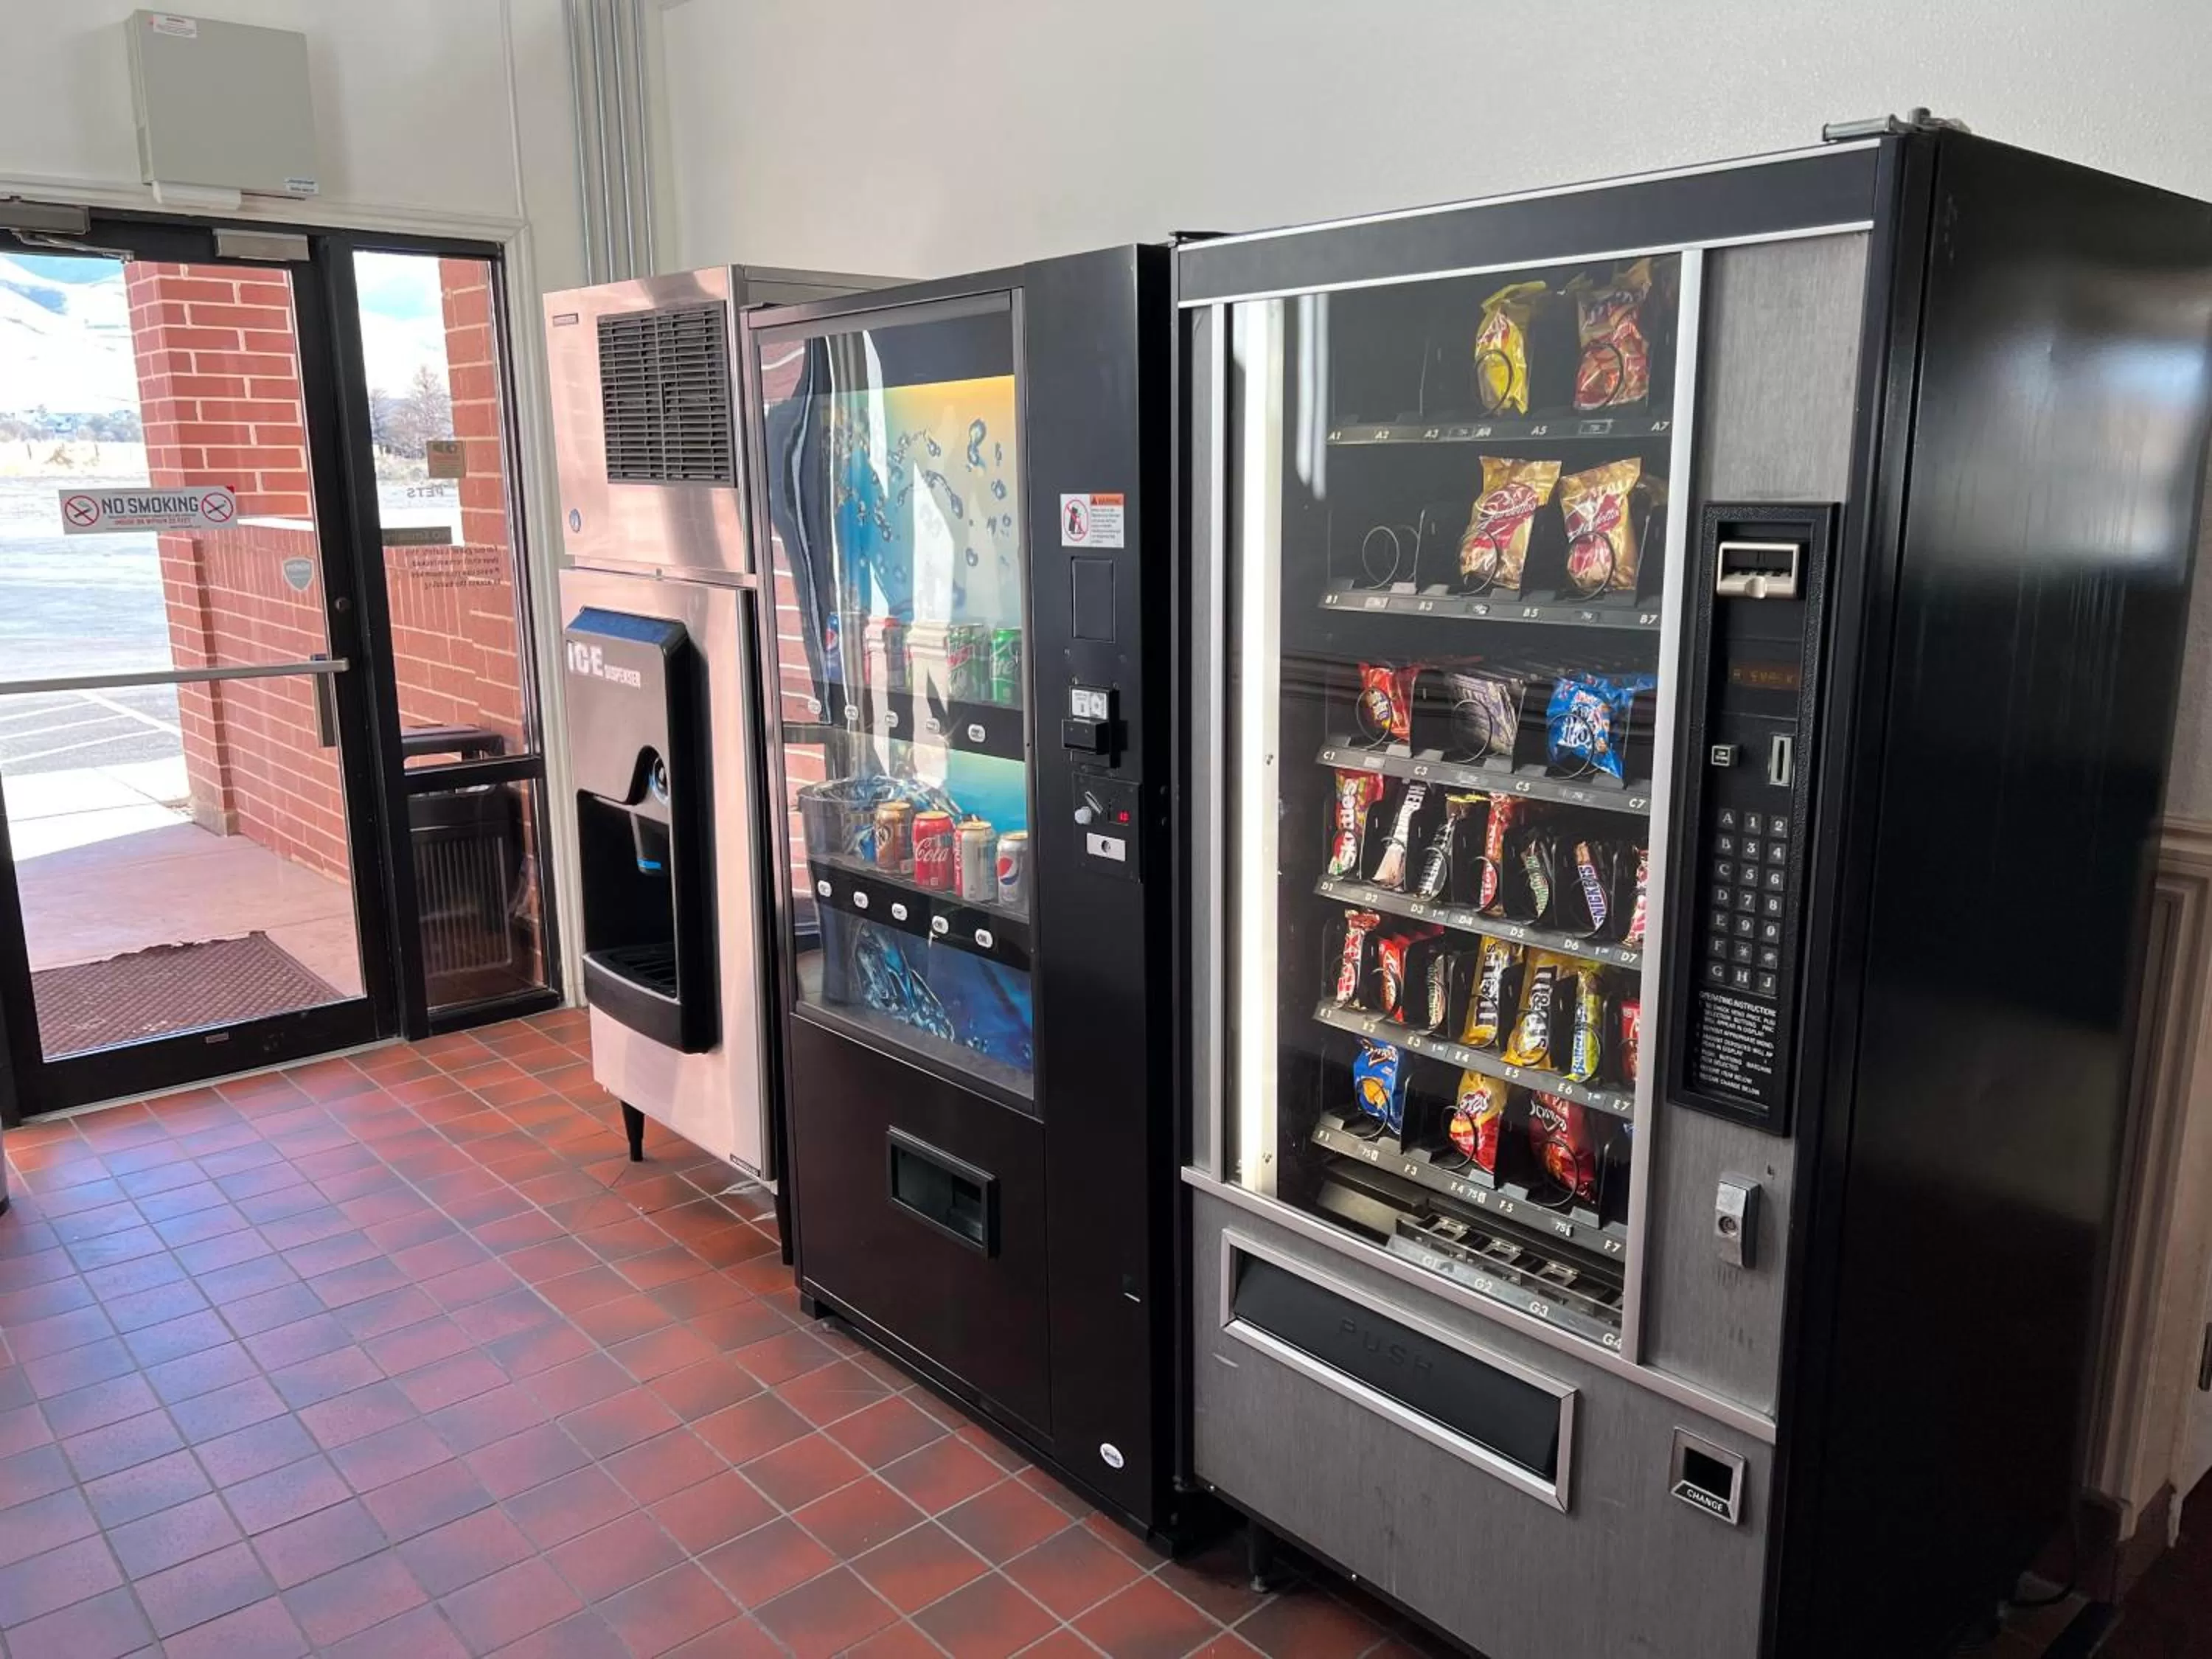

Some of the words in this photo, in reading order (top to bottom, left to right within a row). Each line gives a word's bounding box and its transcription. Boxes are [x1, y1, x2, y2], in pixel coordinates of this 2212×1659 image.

[1531, 424, 1548, 437] A5
[1651, 420, 1670, 432] A7
[1328, 431, 1342, 440] A1
[1374, 430, 1390, 439] A2
[1424, 428, 1439, 439] A3
[102, 498, 125, 515] NO
[128, 495, 199, 514] SMOKING
[1523, 607, 1539, 618] B5
[1640, 613, 1658, 625] B7
[567, 641, 604, 678] ICE
[1323, 751, 1335, 761] C1
[1413, 765, 1428, 775] C3
[1515, 781, 1531, 791] C5
[1629, 798, 1646, 809] C7
[1722, 813, 1733, 824] A
[1749, 816, 1756, 827] 1
[1775, 820, 1784, 831] 2
[1721, 838, 1731, 849] B
[1747, 842, 1756, 853] 3
[1773, 847, 1781, 858] 4
[1718, 863, 1730, 875] C
[1745, 869, 1754, 880] 5
[1770, 873, 1780, 885] 6
[1321, 882, 1334, 891] D1
[1365, 892, 1378, 902] D2
[1578, 865, 1606, 927] SNICKERS
[1717, 889, 1728, 900] D
[1744, 894, 1753, 905] 7
[1411, 903, 1425, 914] D3
[1769, 899, 1778, 911] 8
[1716, 914, 1726, 926] E
[1741, 919, 1750, 931] 9
[1510, 928, 1525, 938] D5
[1564, 939, 1579, 950] D6
[1714, 940, 1723, 951] F
[1621, 950, 1638, 961] D7
[1711, 964, 1723, 977] G
[1736, 970, 1748, 983] H
[1763, 976, 1772, 988] J
[1505, 1068, 1520, 1078] E5
[1557, 1083, 1573, 1094] E6
[1613, 1099, 1631, 1111] E7
[1318, 1130, 1329, 1141] F1
[1405, 1164, 1418, 1175] F3
[1499, 1200, 1514, 1212] F5
[1604, 1239, 1621, 1252] F7
[1474, 1278, 1493, 1293] G2
[1528, 1301, 1548, 1318] G3
[1340, 1318, 1433, 1374] PUSH
[1602, 1332, 1621, 1350] G4
[1686, 1489, 1723, 1512] CHANGE
